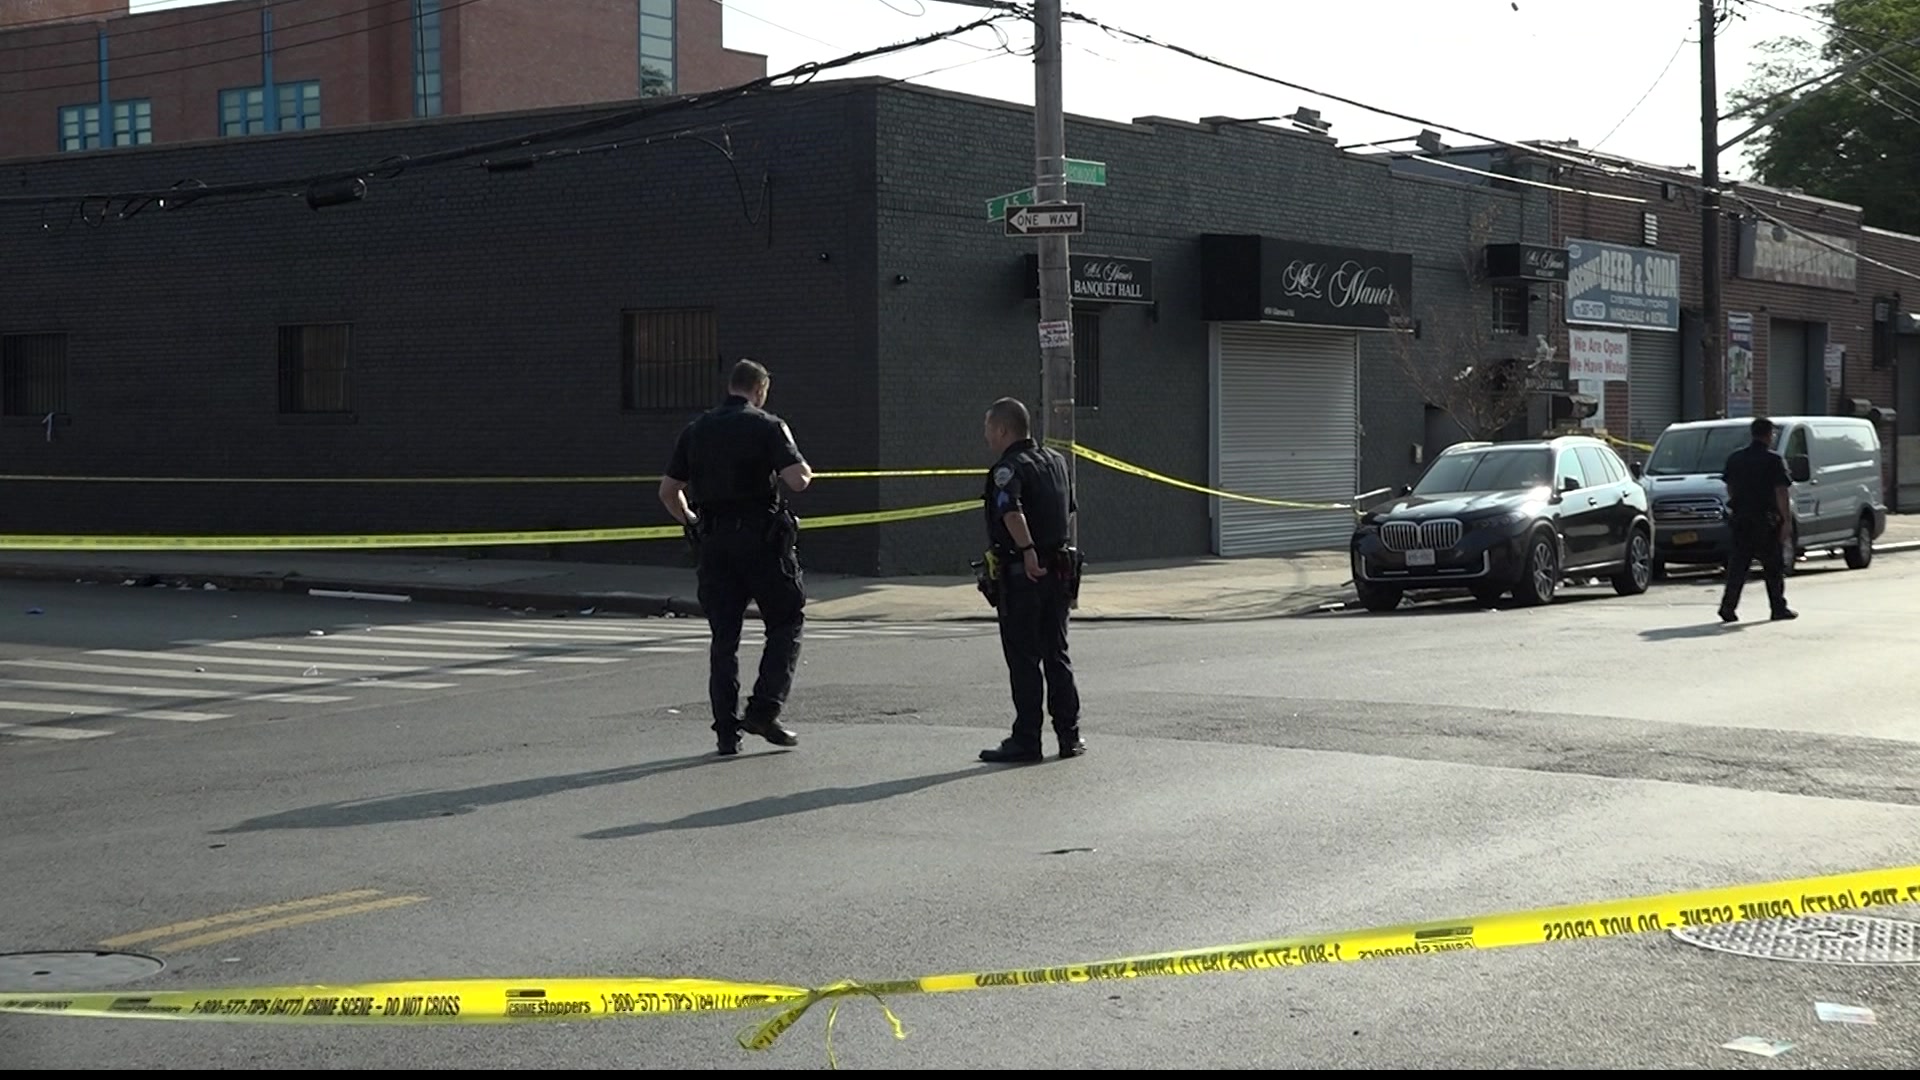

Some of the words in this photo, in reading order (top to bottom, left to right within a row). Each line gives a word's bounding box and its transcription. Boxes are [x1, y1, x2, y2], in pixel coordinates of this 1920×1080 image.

[986, 201, 994, 219] E
[1017, 214, 1039, 226] ONE
[1049, 213, 1073, 225] WAY
[1601, 249, 1633, 294] BEER
[1634, 263, 1643, 295] &
[1645, 255, 1677, 298] SODA
[1074, 280, 1117, 298] BANQUET
[1118, 283, 1143, 298] HALL
[1328, 260, 1394, 308] Manor
[1574, 336, 1587, 352] We
[1588, 338, 1602, 354] Are
[1603, 339, 1624, 357] Open
[1570, 358, 1581, 372] We
[1583, 359, 1603, 374] Have
[1604, 361, 1627, 375] Water
[190, 998, 271, 1014] 1-800-577-TIPS
[268, 996, 304, 1015] (8477)
[303, 996, 340, 1016] CRIME
[337, 996, 374, 1016] SCENE
[383, 996, 401, 1016] DO
[401, 996, 425, 1016] NOT
[425, 995, 461, 1016] CROSS
[600, 993, 693, 1013] 1-800-577-TIPS
